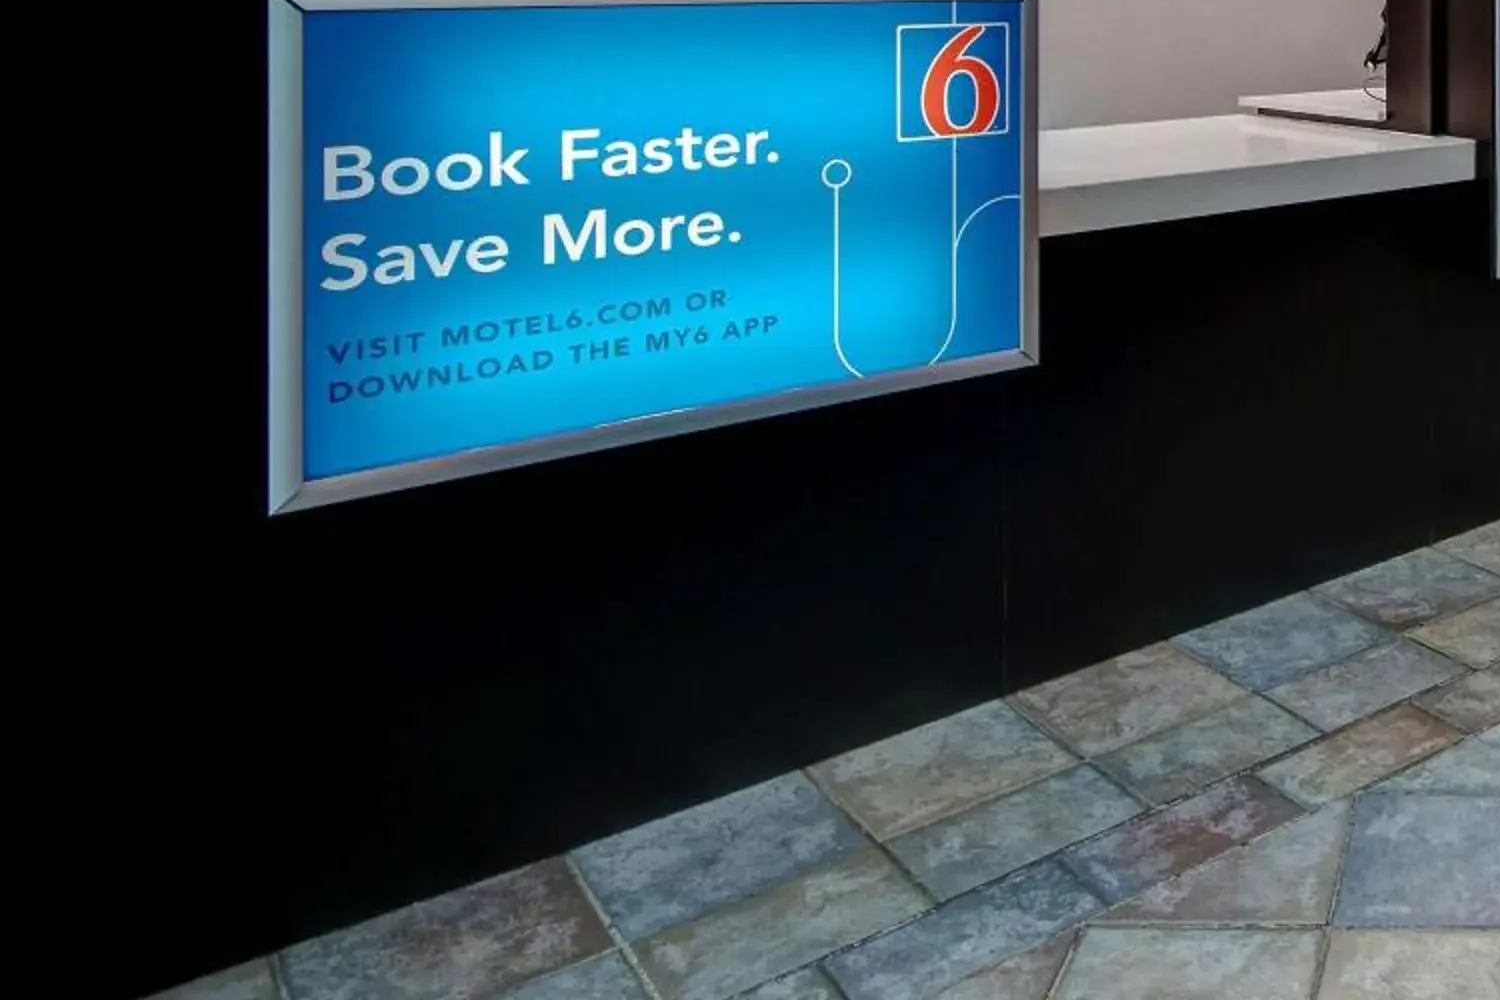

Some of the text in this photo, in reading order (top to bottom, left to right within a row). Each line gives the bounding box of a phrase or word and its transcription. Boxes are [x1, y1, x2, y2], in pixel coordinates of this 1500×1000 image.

[921, 23, 1000, 138] 6
[322, 126, 780, 202] Book Faster.
[320, 207, 743, 292] Save More.
[326, 288, 727, 366] VISIT MOTEL6.COM OR
[328, 314, 779, 404] DOWNLOAD THE MY6 APP
